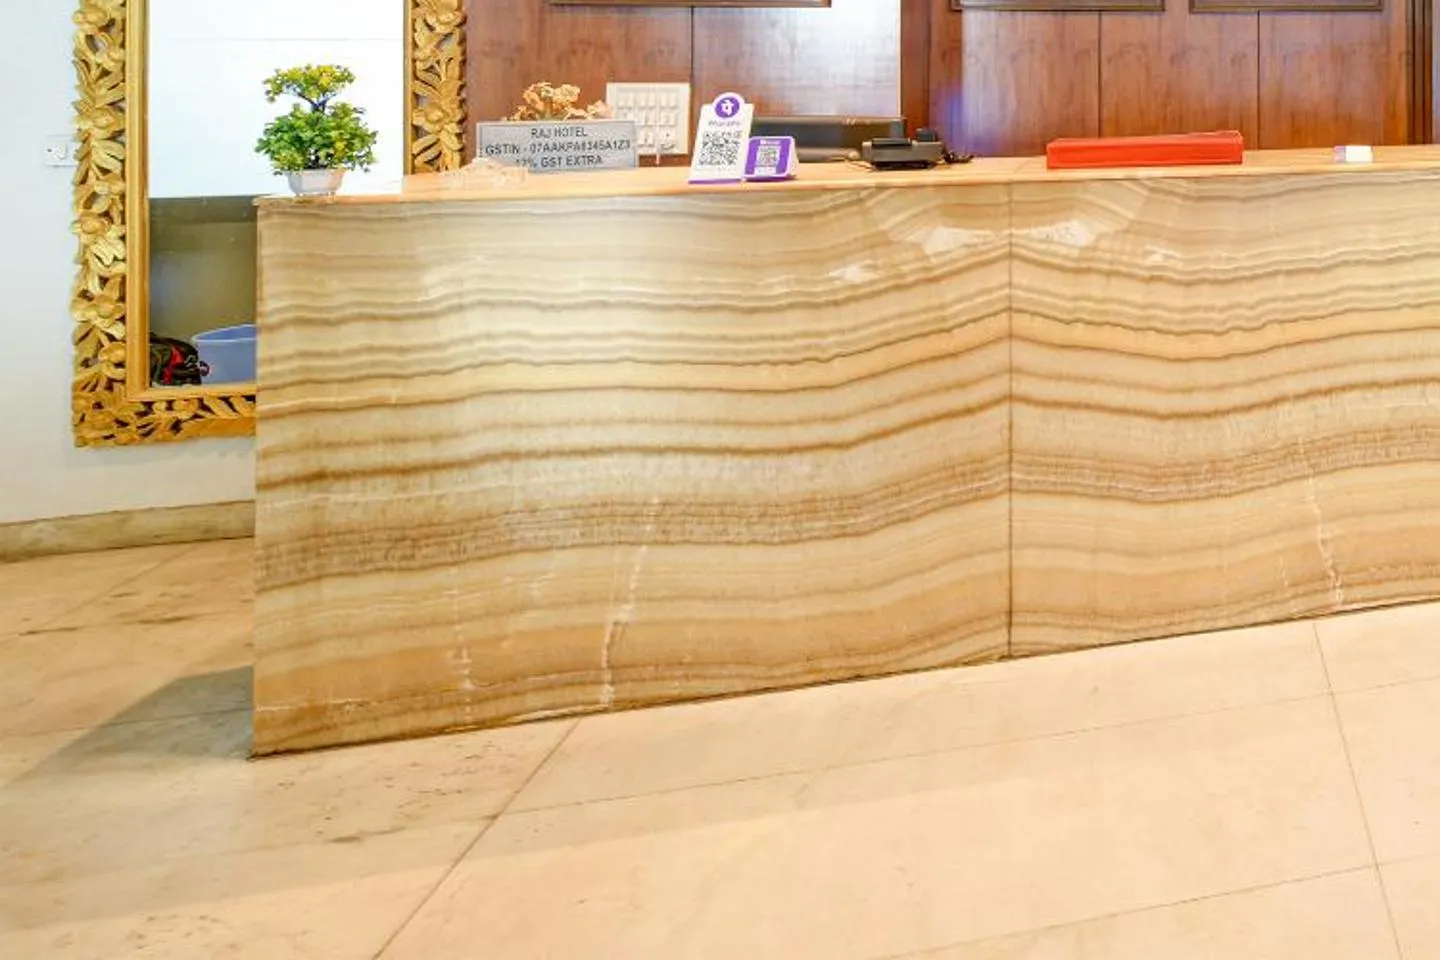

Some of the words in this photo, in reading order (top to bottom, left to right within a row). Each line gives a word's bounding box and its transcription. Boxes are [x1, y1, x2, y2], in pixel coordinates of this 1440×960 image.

[531, 128, 552, 138] RAJ
[554, 126, 588, 137] HOTEL
[485, 143, 520, 156] GSTIN
[541, 156, 563, 168] GST
[566, 155, 603, 166] EXTRA
